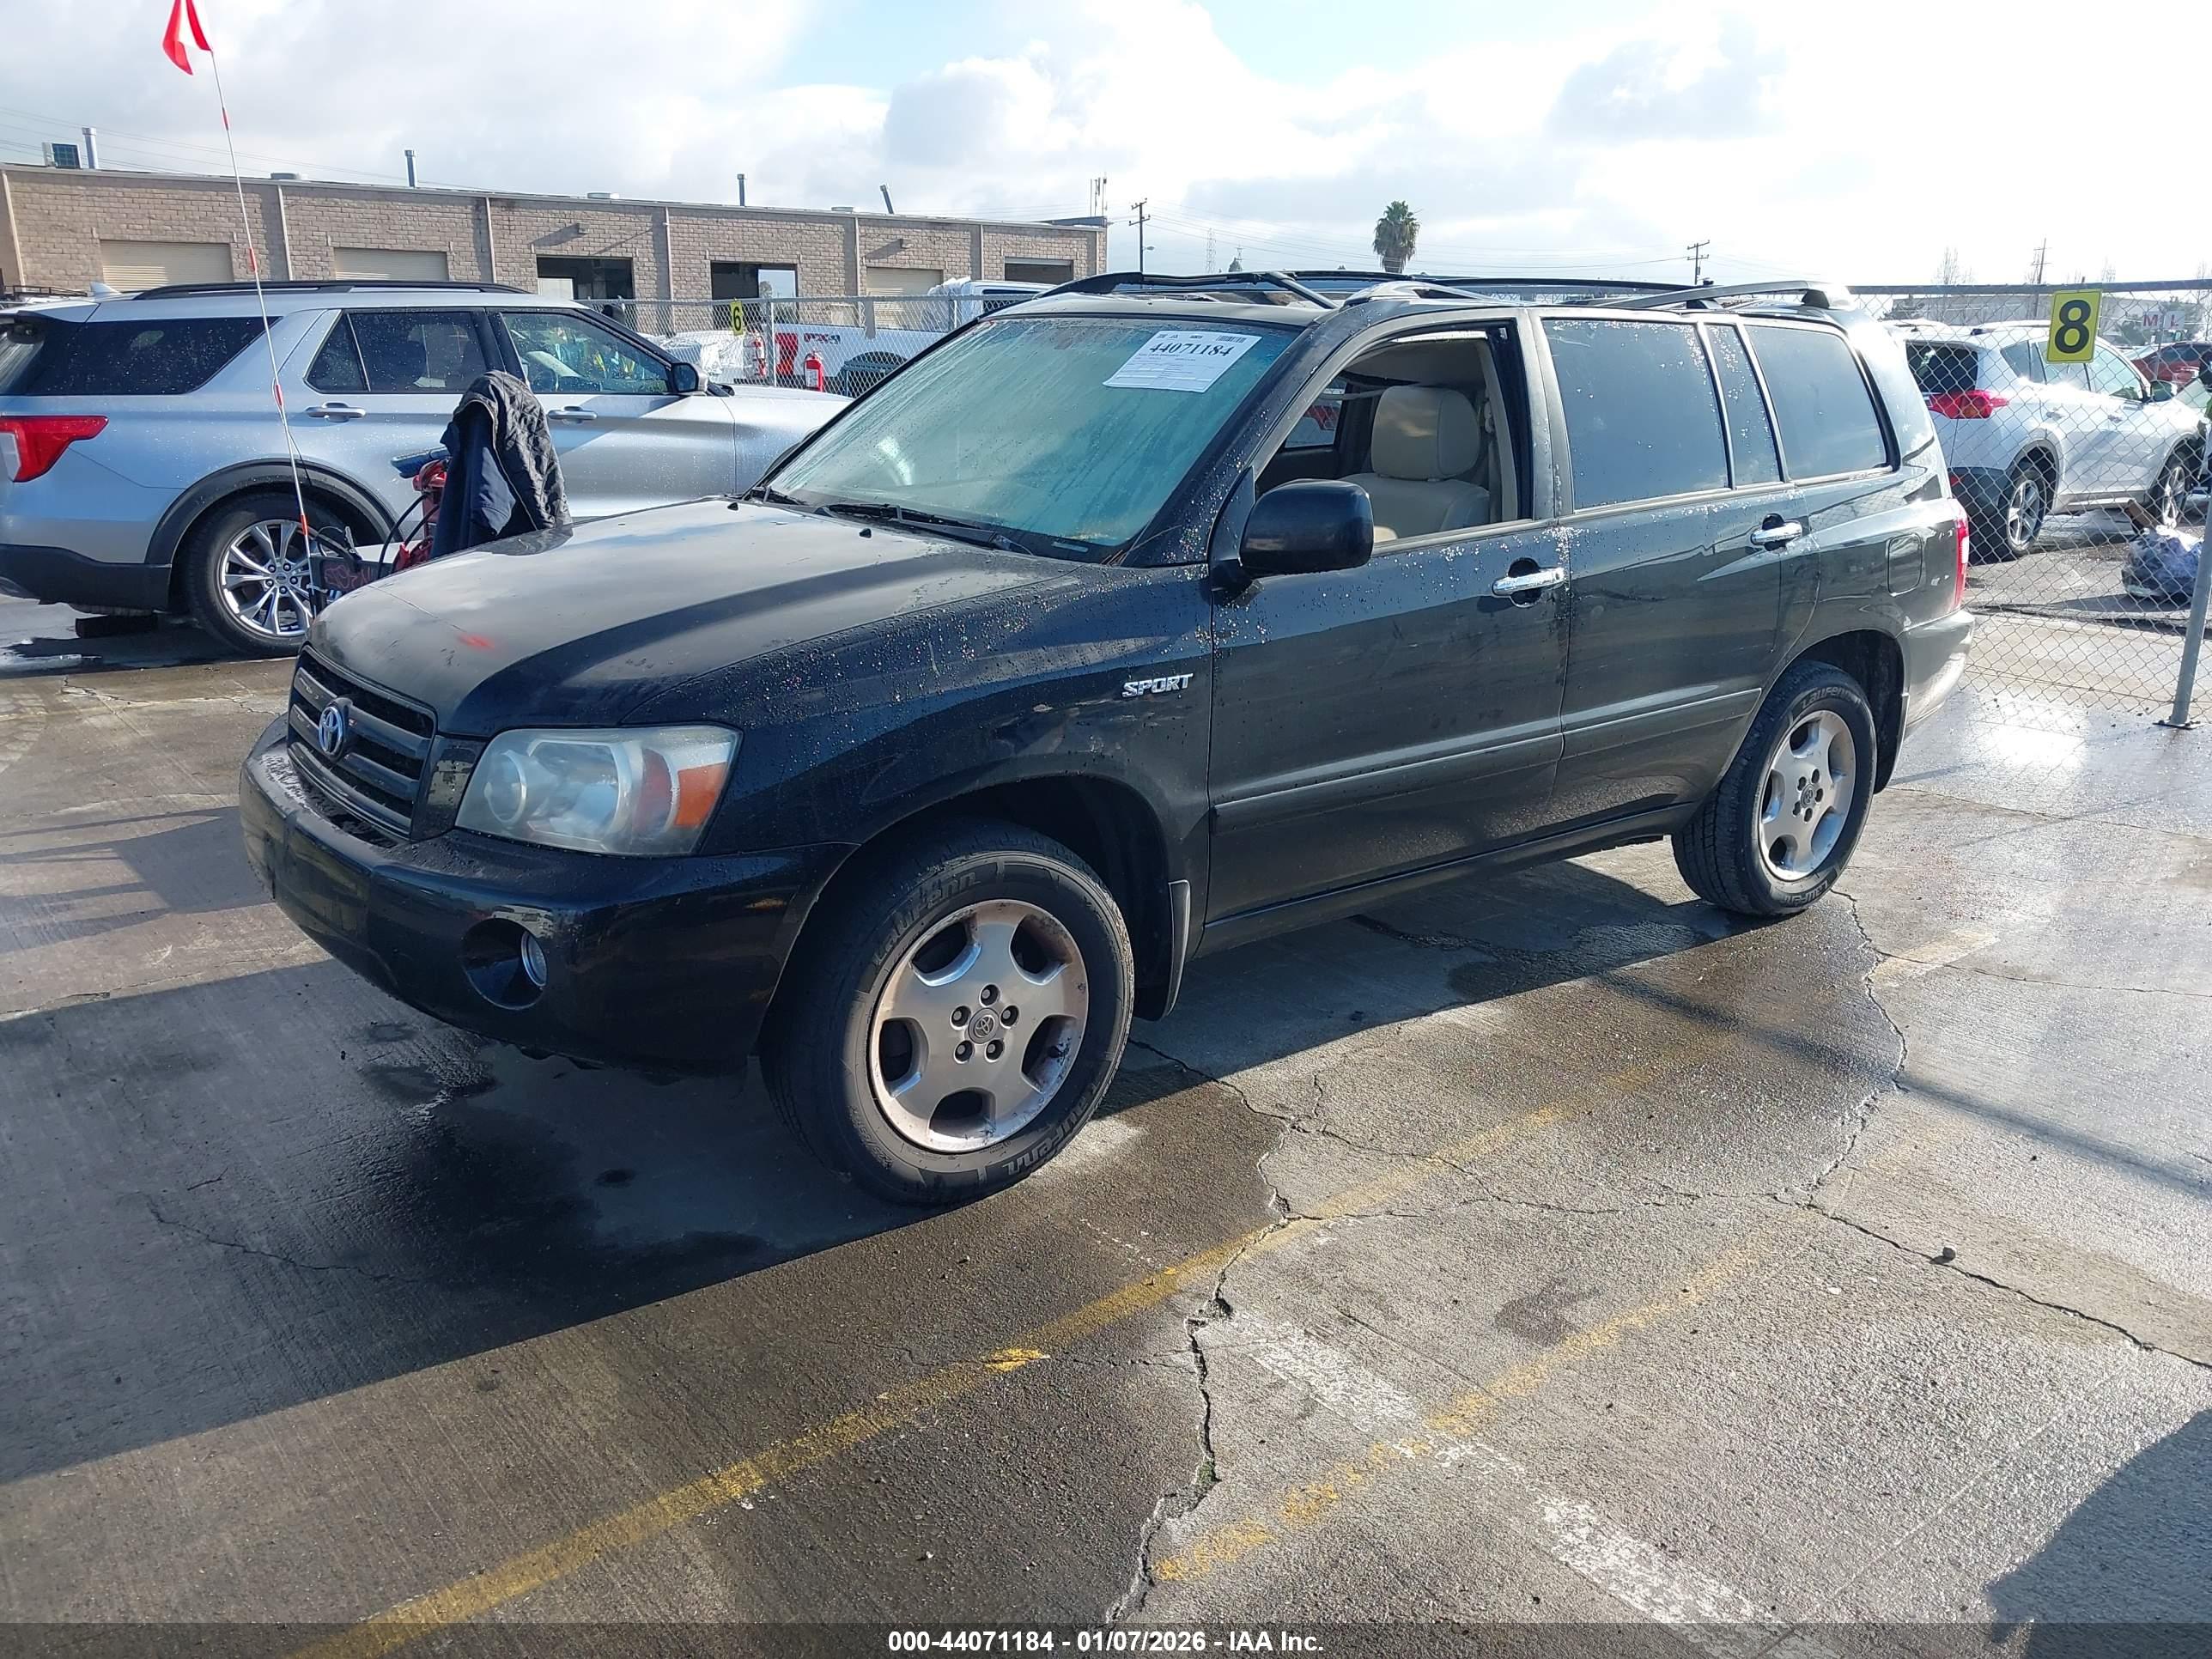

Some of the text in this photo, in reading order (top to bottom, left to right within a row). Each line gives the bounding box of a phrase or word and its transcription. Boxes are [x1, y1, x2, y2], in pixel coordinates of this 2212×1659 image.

[732, 306, 742, 331] 6
[2055, 300, 2091, 354] 8
[2143, 314, 2158, 326] M
[1149, 343, 1235, 356] 44071184
[1121, 673, 1194, 697] SPORT
